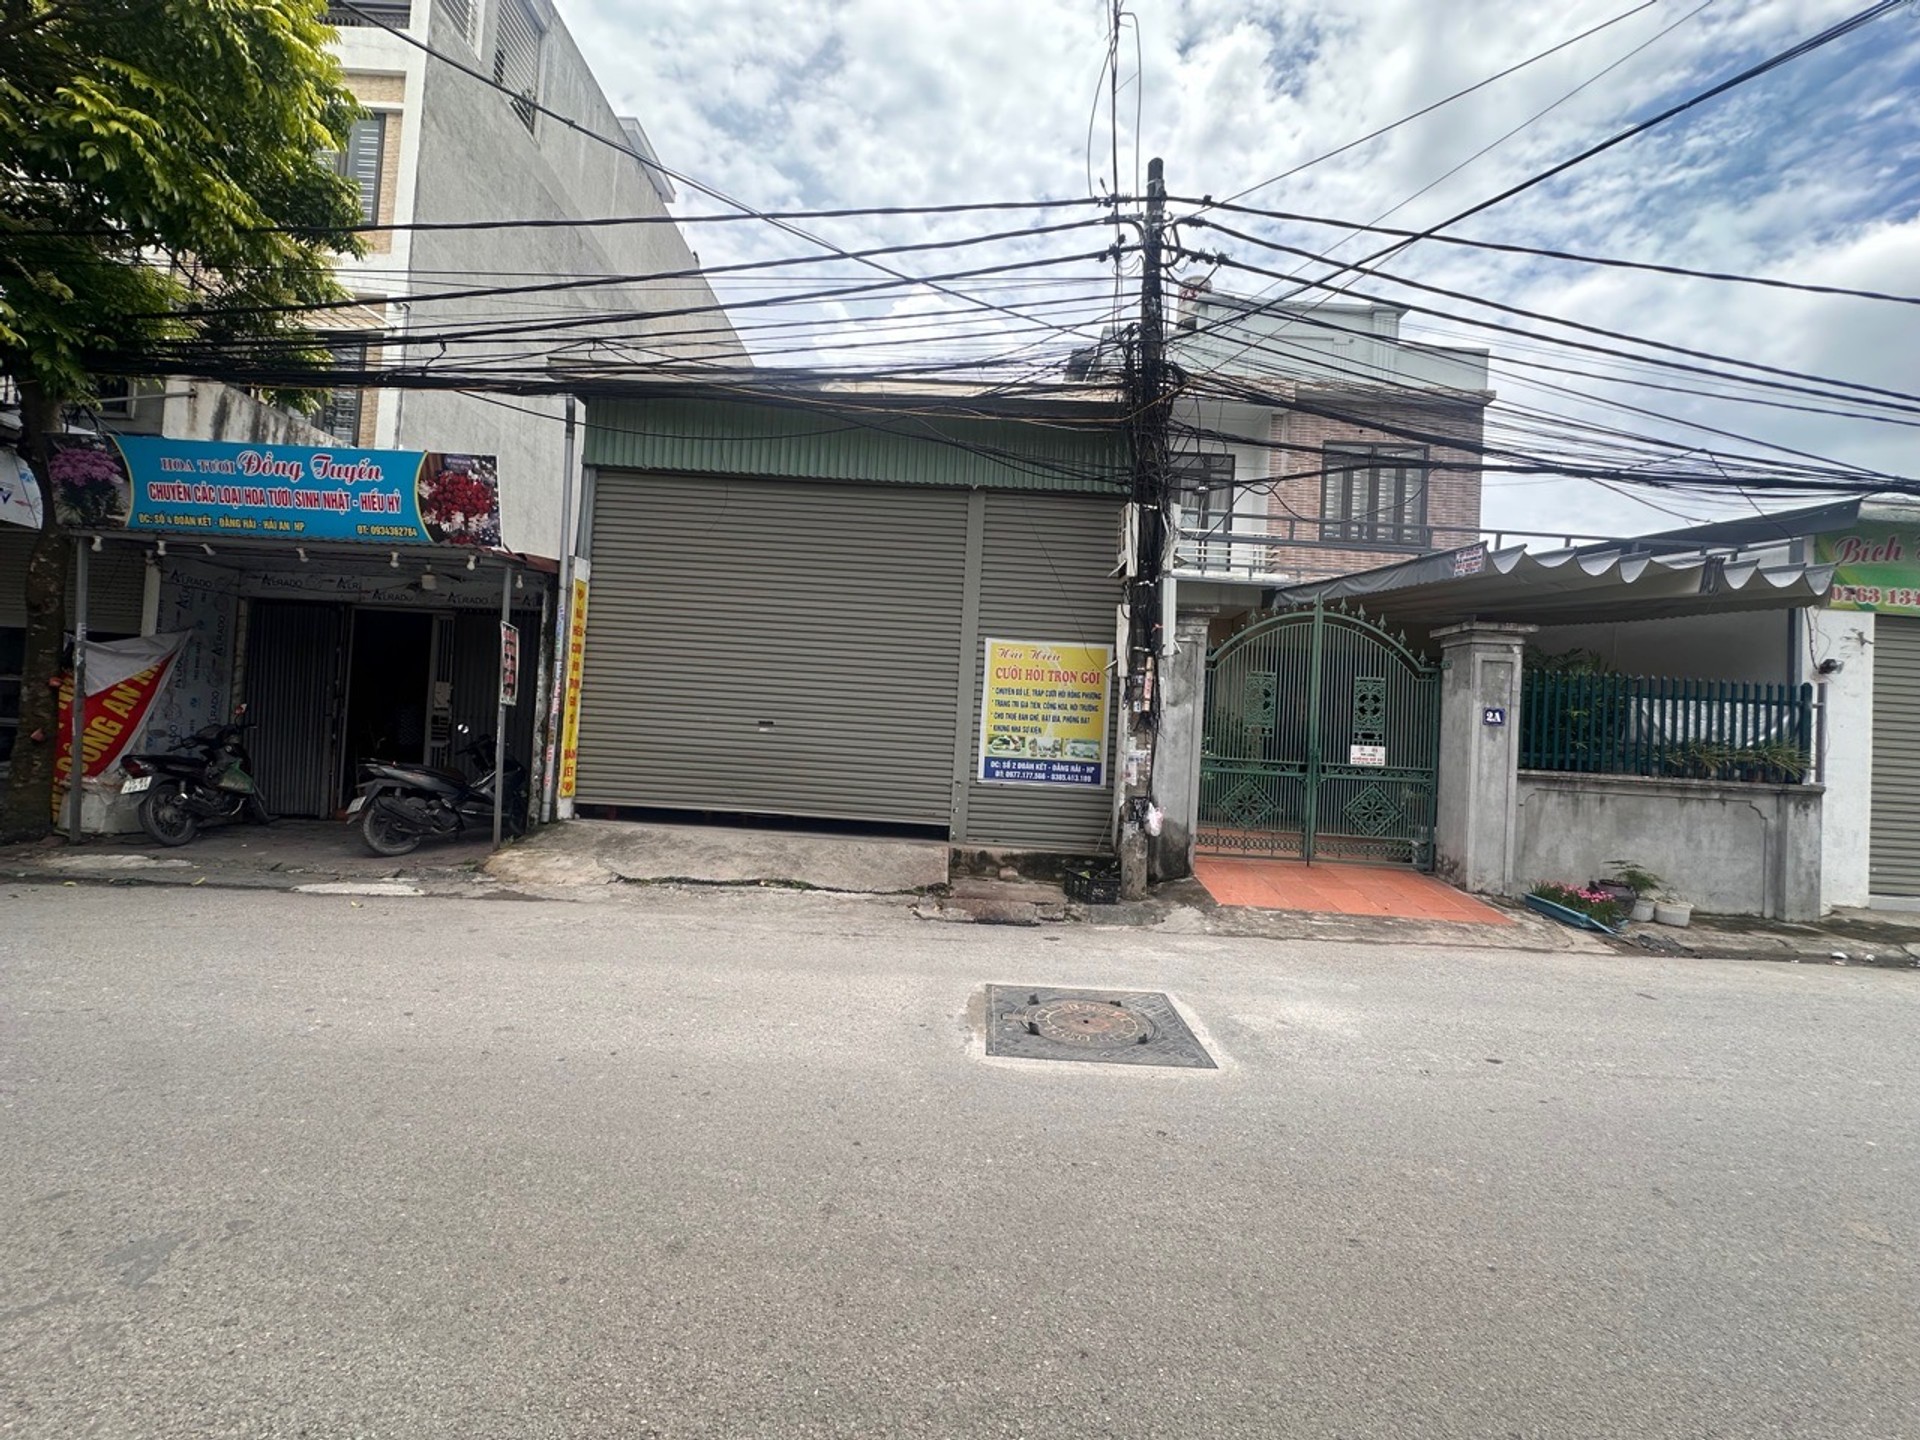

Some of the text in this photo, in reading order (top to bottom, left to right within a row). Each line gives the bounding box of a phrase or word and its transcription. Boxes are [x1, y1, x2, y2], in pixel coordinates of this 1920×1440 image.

[161, 458, 195, 473] HOA
[236, 450, 305, 483] Đồng
[147, 479, 191, 503] CHUYÊN
[193, 480, 216, 504] CÁC
[217, 485, 242, 509] LOẠI
[244, 486, 267, 508] HOA
[267, 487, 293, 509] TƯƠI
[294, 489, 320, 511] SINH
[322, 488, 351, 515] NHẬT
[359, 488, 385, 512] HIẾU
[279, 521, 290, 531] AN
[294, 521, 305, 531] HP
[1025, 664, 1045, 682] HỎI
[1048, 670, 1078, 686] TRỌN
[1081, 669, 1101, 684] GÓI
[102, 682, 142, 720] AN
[1486, 711, 1501, 722] 2A
